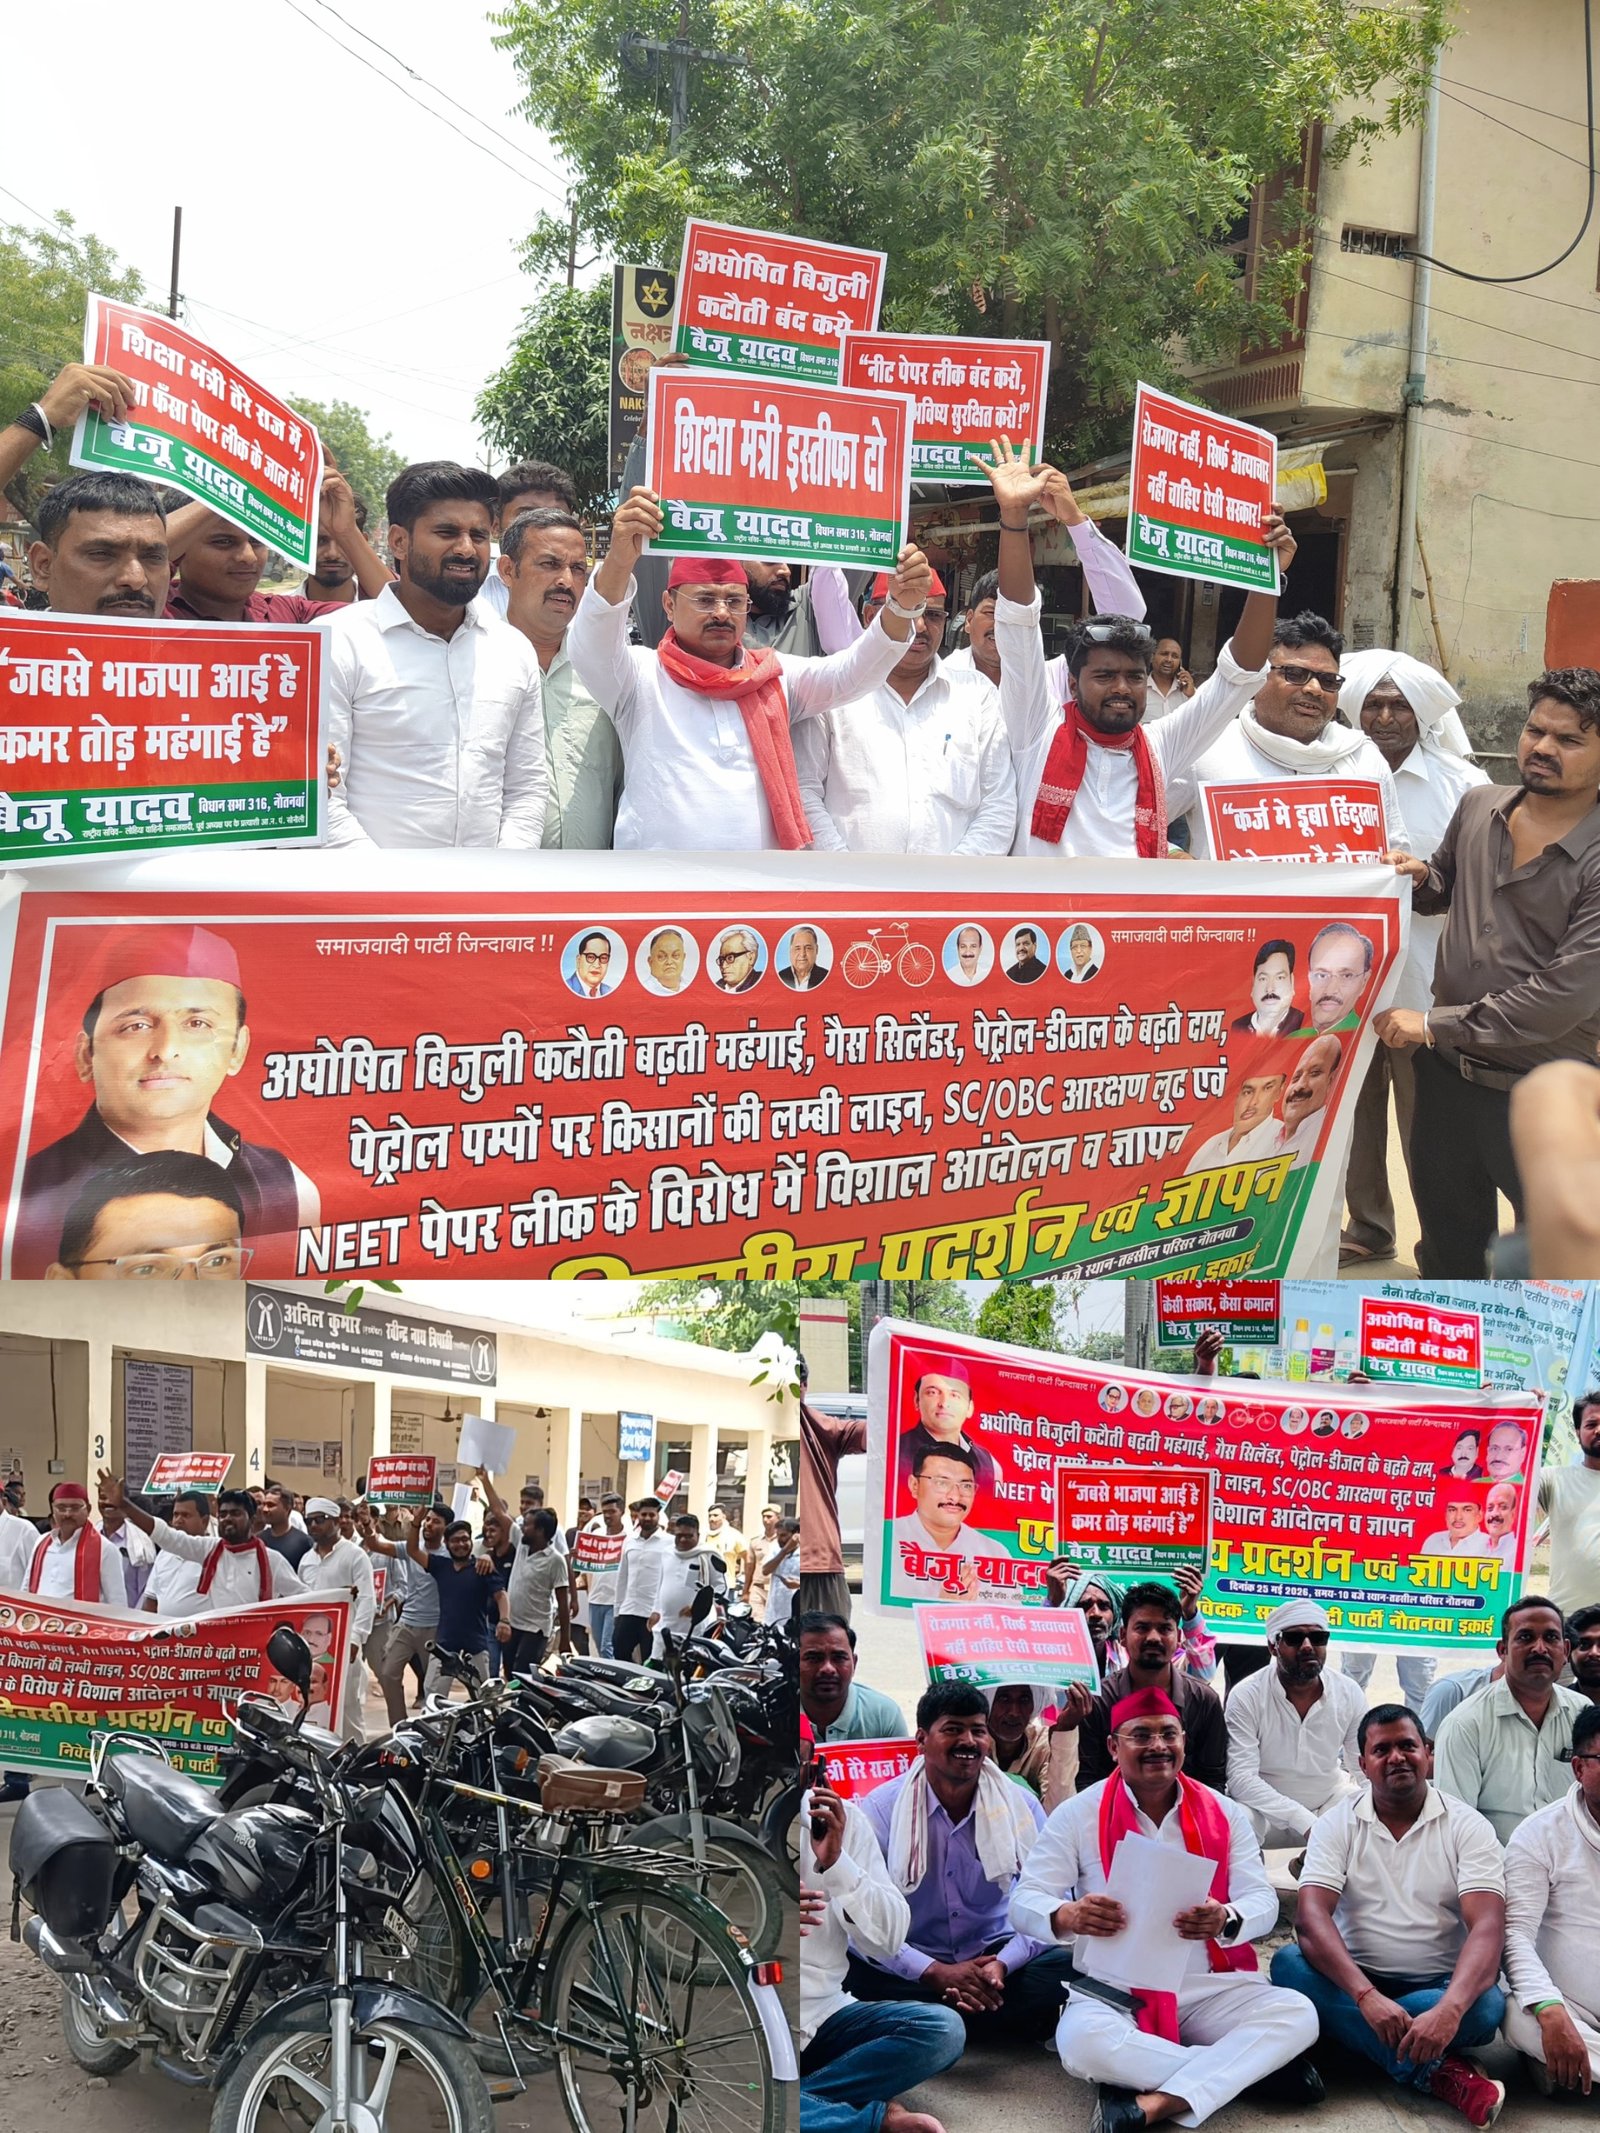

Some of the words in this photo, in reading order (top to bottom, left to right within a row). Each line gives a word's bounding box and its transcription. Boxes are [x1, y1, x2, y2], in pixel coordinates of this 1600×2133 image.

[694, 248, 788, 287] अघोषित
[793, 260, 869, 303] बिजुली
[698, 292, 768, 327] कटौती
[776, 302, 809, 332] बंद
[859, 354, 895, 384] “नीट
[898, 354, 930, 385] पेपर
[932, 357, 967, 387] लीक
[969, 358, 991, 389] बंद
[994, 360, 1026, 395] करो,
[121, 323, 186, 376] शिक्षा
[189, 359, 226, 401] मंत्री
[230, 379, 252, 419] तेरे
[255, 402, 286, 441] राज
[289, 420, 305, 461] में,
[619, 396, 646, 410] NAK
[952, 399, 994, 435] सुरक्षित
[994, 400, 1030, 430] करो!”
[152, 381, 188, 425] फँसा
[191, 399, 219, 443] पेपर
[221, 424, 249, 461] लीक
[264, 454, 288, 492] जाल
[674, 398, 735, 476] शिक्षा
[741, 401, 782, 481] मंत्री
[786, 411, 859, 493] इस्तीफा
[864, 417, 886, 493] दो
[1143, 412, 1178, 456] रोजगार
[1179, 429, 1203, 469] नहीं,
[1207, 436, 1229, 470] सिर्फ
[1231, 449, 1269, 484] अत्याचार
[1148, 471, 1167, 504] नहीं
[1168, 478, 1201, 513] चाहिए
[1203, 483, 1224, 519] ऐसी
[1226, 496, 1261, 528] सरकार!
[666, 500, 727, 541] बैजू
[734, 511, 812, 540] यादव
[851, 527, 867, 542] 316,
[102, 662, 202, 697] भाजपा
[210, 653, 272, 703] आई
[273, 654, 300, 698] है
[0, 726, 72, 764] कमर
[79, 714, 137, 770] तोड़
[144, 713, 244, 764] महंगाई
[246, 712, 288, 757] है”
[81, 793, 194, 826] यादव
[248, 797, 270, 813] 316,
[1222, 798, 1270, 831] “कर्ज
[1295, 803, 1328, 837] डूबा
[316, 934, 408, 955] समाजवादी
[415, 932, 451, 953] पार्टी
[457, 934, 536, 955] जिन्दाबाद
[1111, 929, 1167, 943] समाजवादी
[1171, 927, 1193, 943] पार्टी
[1196, 929, 1244, 943] जिन्दाबाद
[261, 1038, 407, 1099] अघोषित
[416, 1032, 525, 1103] बिजुली
[534, 1025, 627, 1083] कटौती
[635, 1023, 709, 1089] बढ़ती
[715, 1016, 814, 1076] महंगाई,
[823, 1016, 868, 1064] गैस
[875, 1009, 965, 1069] सिलेंडर,
[973, 1009, 1109, 1064] पेट्रोल-डीजल
[1113, 1008, 1134, 1046] के
[1137, 1004, 1181, 1055] बढ़ते
[1187, 1009, 1228, 1046] दाम,
[349, 1115, 452, 1185] पेट्रोल
[462, 1105, 542, 1166] पम्पों
[550, 1115, 595, 1159] पर
[601, 1093, 717, 1156] किसानों
[722, 1094, 763, 1144] की
[770, 1086, 842, 1139] लम्बी
[849, 1087, 933, 1137] लाइन,
[943, 1078, 1053, 1127] SC/OBC
[1062, 1073, 1147, 1113] आरक्षण
[1151, 1071, 1187, 1113] लूट
[1193, 1056, 1228, 1101] एवं
[297, 1216, 408, 1275] NEET
[420, 1200, 502, 1260] पेपर
[509, 1190, 596, 1248] लीक
[602, 1181, 640, 1237] के
[649, 1160, 762, 1232] विरोध
[772, 1153, 807, 1214] में
[816, 1151, 937, 1210] विशाल
[942, 1130, 1078, 1193] आंदोलन
[1107, 1123, 1193, 1167] ज्ञापन
[1090, 1187, 1140, 1244] एवं
[1154, 1151, 1299, 1231] ज्ञापन
[1162, 1236, 1194, 1256] परिसर
[284, 1302, 324, 1328] अनिल
[1185, 1297, 1216, 1314] सरकार,
[1219, 1292, 1242, 1311] कैसा
[1243, 1298, 1274, 1312] कमाल
[1365, 1310, 1424, 1335] अघोषित
[1427, 1318, 1475, 1341] बिजुली
[1371, 1336, 1419, 1358] कटौती
[1421, 1339, 1441, 1362] बंद
[1443, 1340, 1468, 1364] करो
[95, 1435, 104, 1458] 3
[250, 1448, 259, 1471] 4
[979, 1413, 1033, 1438] अघोषित
[1036, 1419, 1081, 1449] बिजुली
[1240, 1440, 1284, 1468] सिलेंडर,
[1289, 1446, 1364, 1473] पेट्रोल-डीजल
[1013, 1445, 1051, 1473] पेट्रोल
[994, 1481, 1032, 1502] NEET
[1068, 1480, 1110, 1503] “जबसे
[1114, 1482, 1156, 1504] भाजपा
[1160, 1483, 1188, 1507] आई
[1071, 1514, 1102, 1531] कमर
[1105, 1512, 1129, 1536] तोड़
[1132, 1511, 1175, 1536] महंगाई
[1176, 1513, 1195, 1533] है”
[900, 1540, 968, 1593] बैजू
[1240, 1536, 1355, 1581] प्रदर्शन
[1407, 1555, 1503, 1591] ज्ञापन
[1258, 1582, 1268, 1594] 25
[1347, 1609, 1384, 1631] पार्टी
[1388, 1609, 1453, 1633] नौतनवा
[1458, 1613, 1494, 1637] इकाई
[20, 1675, 58, 1698] विरोध
[77, 1678, 122, 1701] विशाल
[93, 1662, 125, 1680] लाइन,
[129, 1663, 175, 1682] SC/OBC
[850, 1756, 867, 1780] तेरे
[869, 1759, 895, 1779] राज
